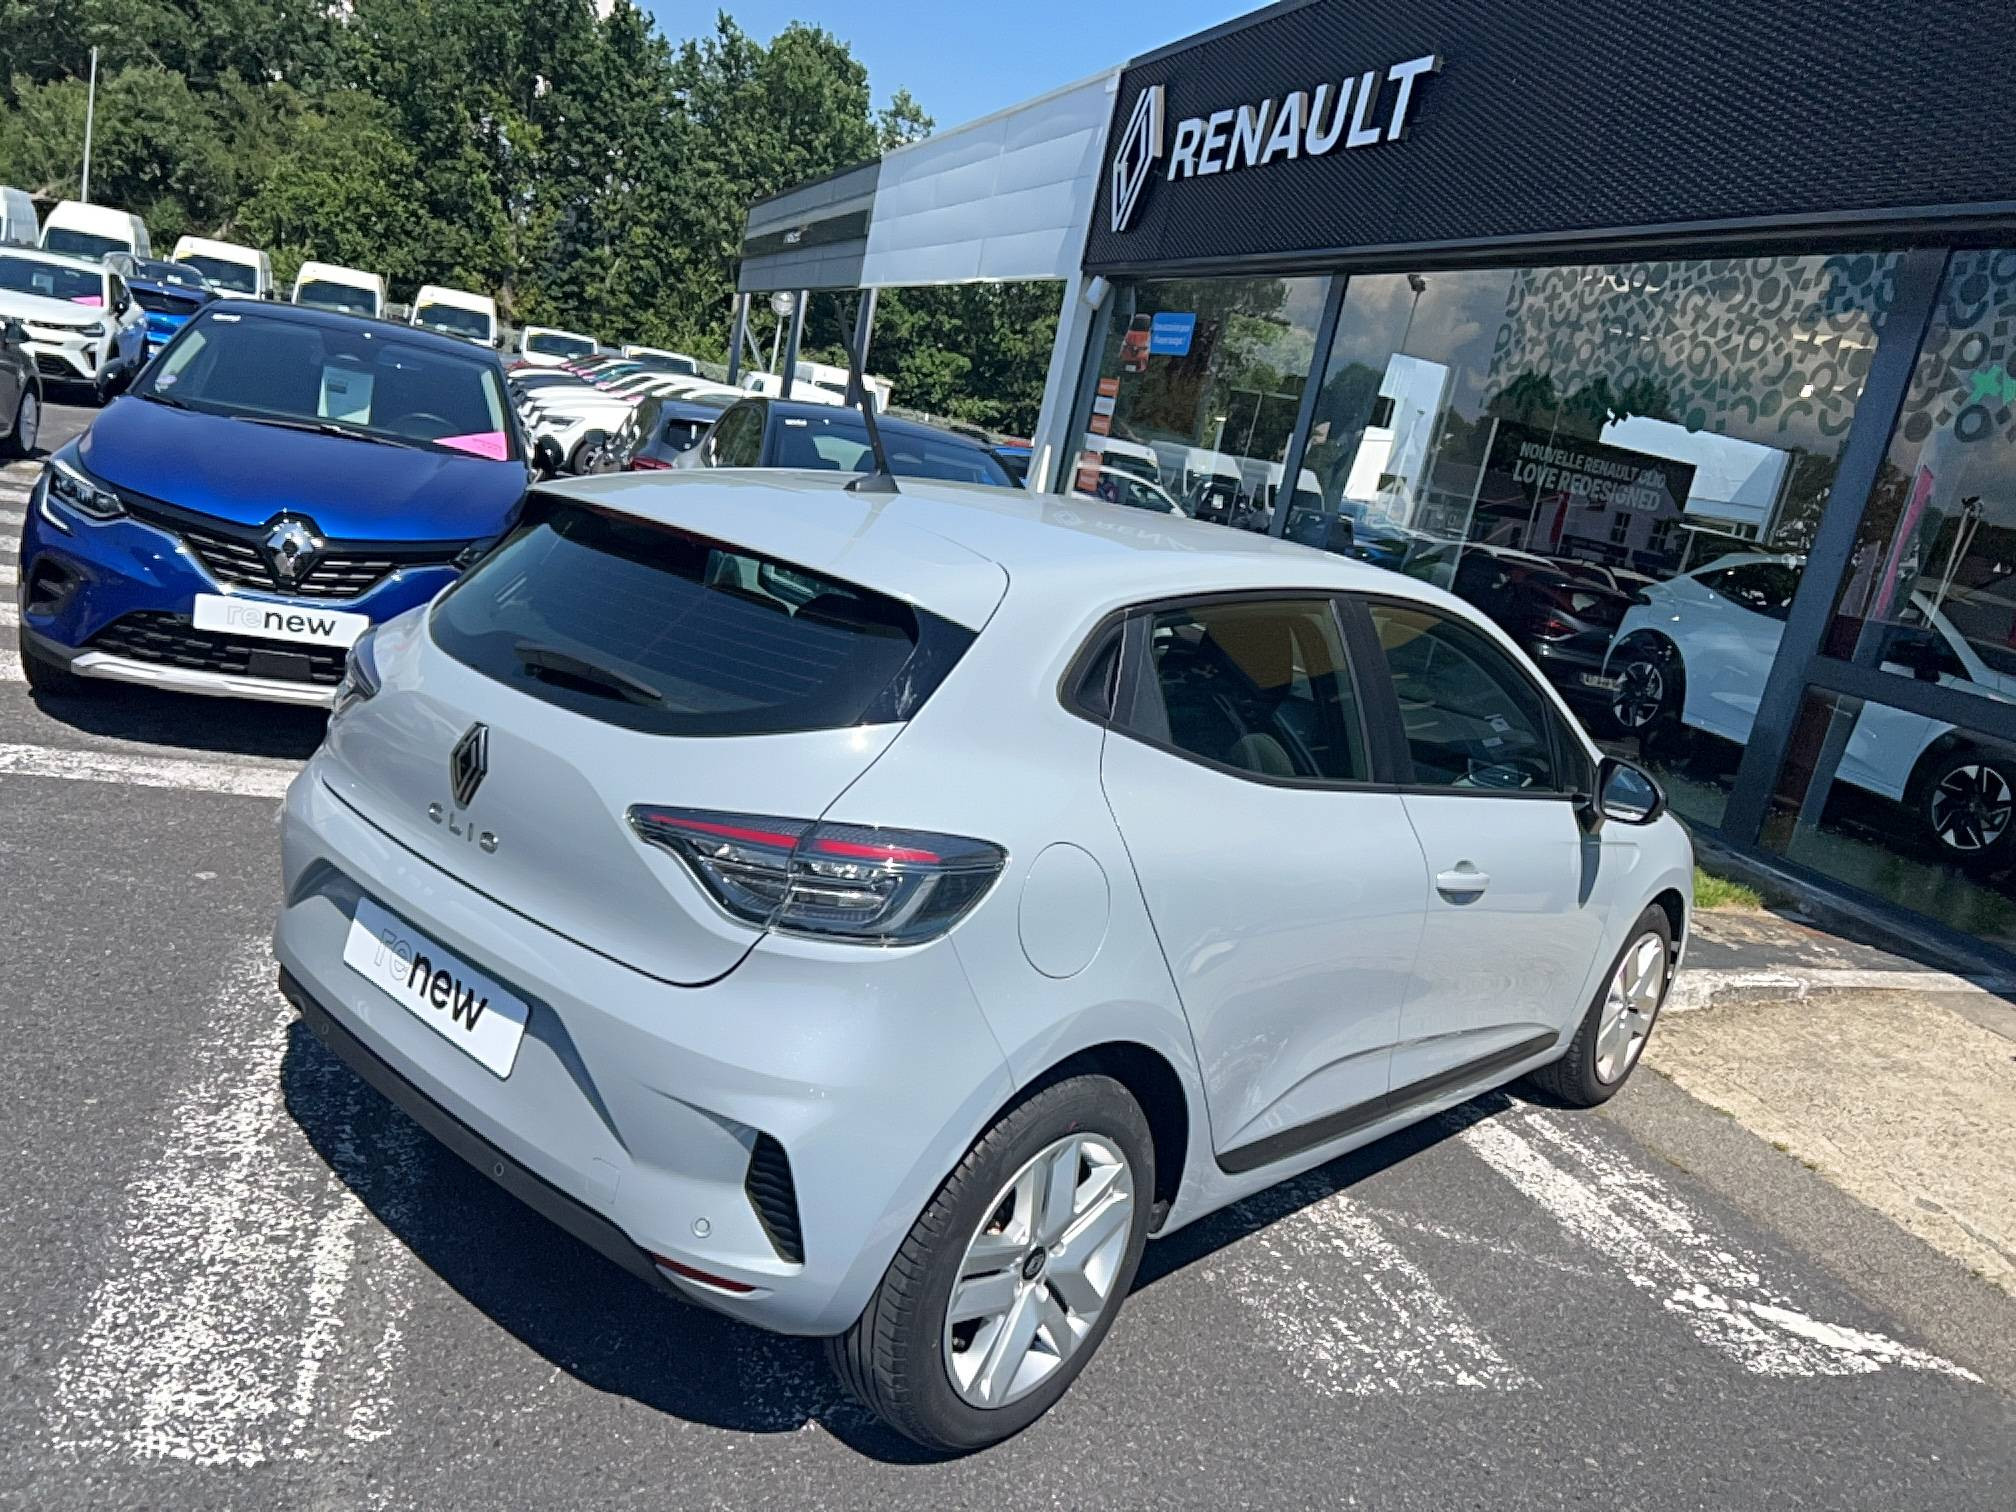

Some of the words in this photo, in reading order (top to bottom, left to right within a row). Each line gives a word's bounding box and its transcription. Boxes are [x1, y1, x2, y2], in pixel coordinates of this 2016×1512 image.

[1167, 54, 1442, 181] RENAULT
[1511, 459, 1560, 490] LOVE
[1557, 470, 1661, 511] REDESIGNED
[1520, 441, 1585, 468] NOUVELLE
[1583, 456, 1641, 482] RENAULT
[227, 605, 336, 637] renew
[427, 802, 499, 854] CLIO
[373, 928, 488, 1032] renew
